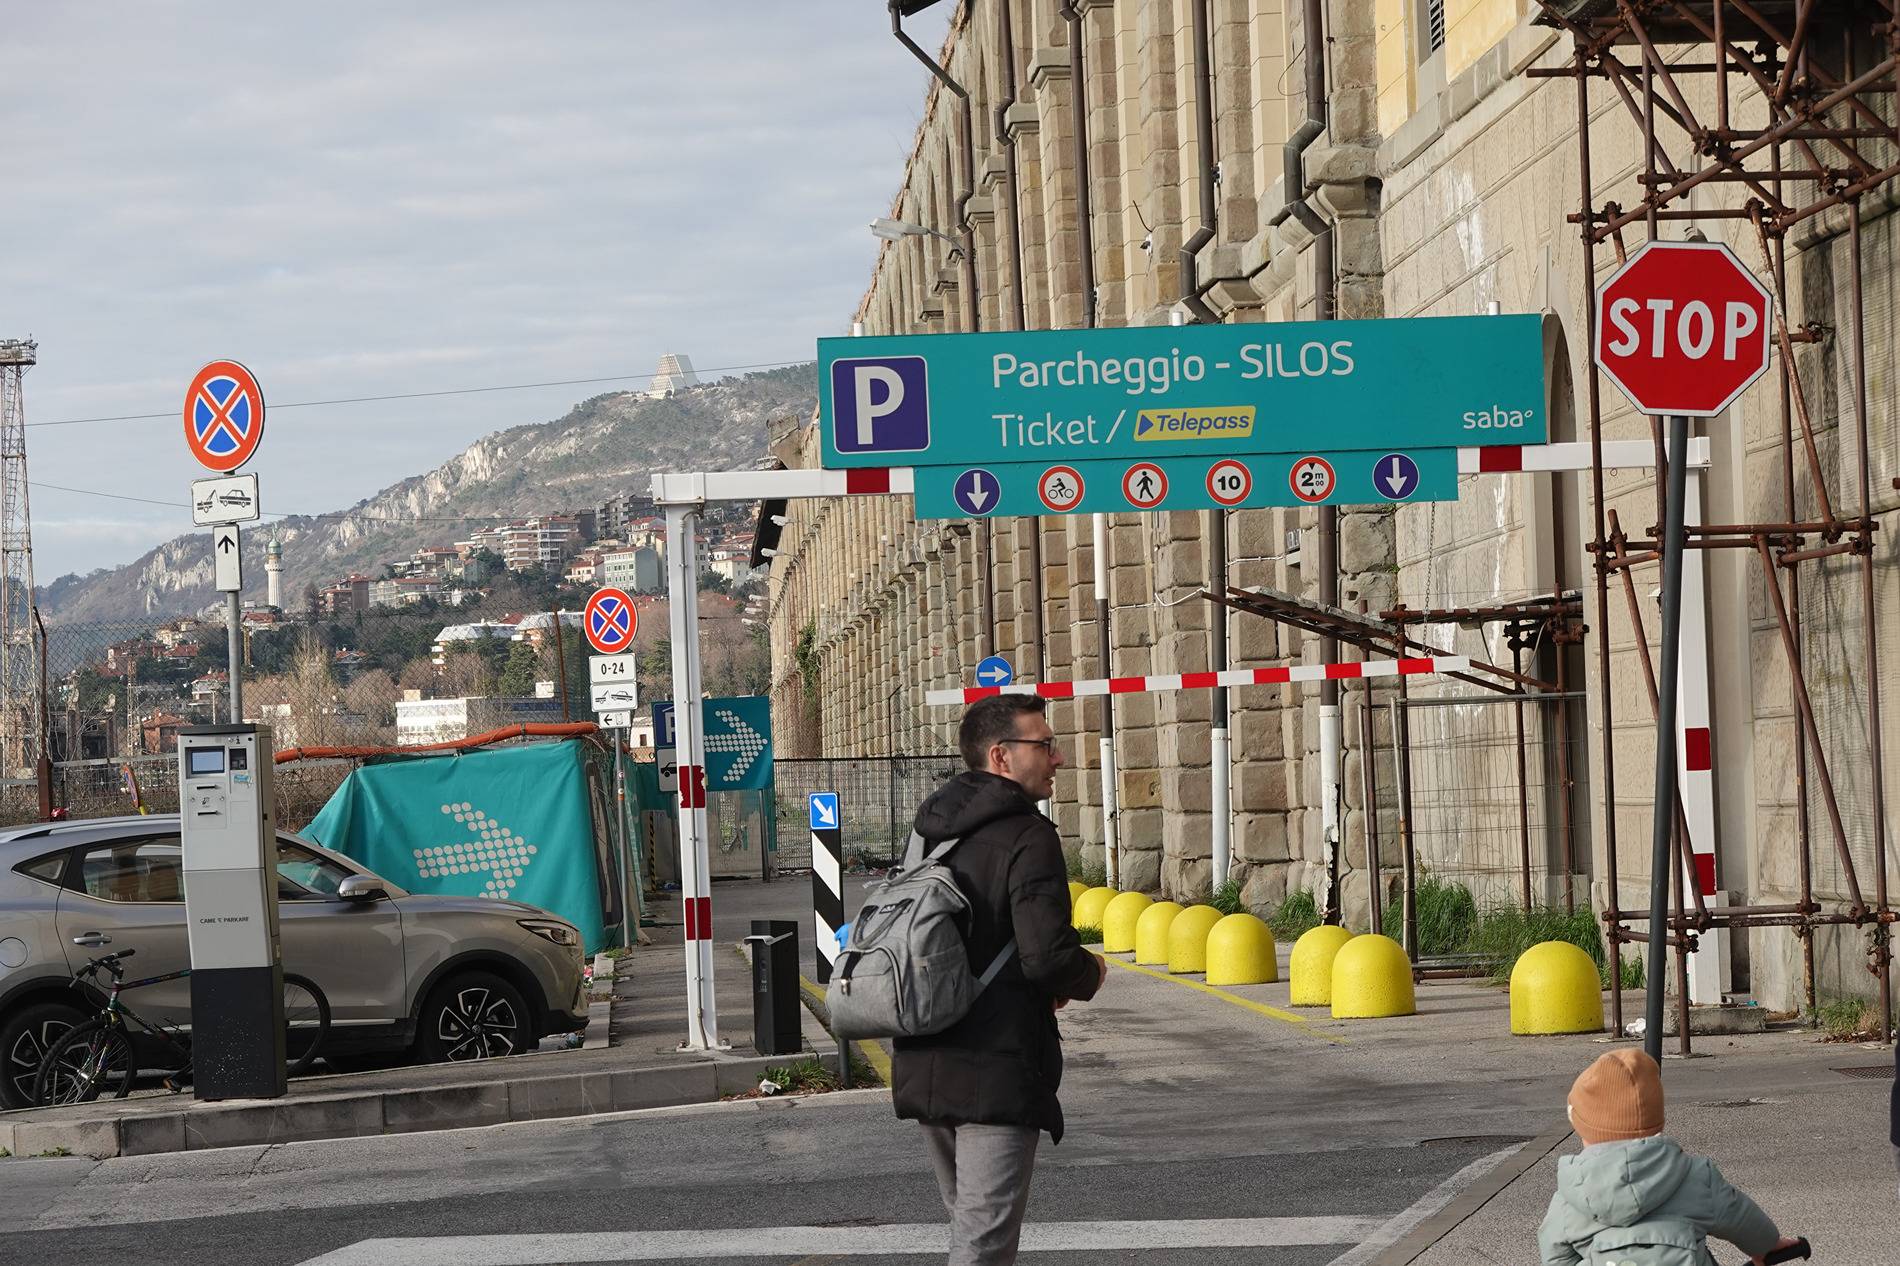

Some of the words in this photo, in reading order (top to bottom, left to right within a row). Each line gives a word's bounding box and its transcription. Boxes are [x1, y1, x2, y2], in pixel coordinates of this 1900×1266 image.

[1608, 297, 1758, 361] STOP
[992, 347, 1206, 395] Parcheggio
[1239, 340, 1355, 379] SILOS
[854, 365, 905, 445] P
[991, 411, 1099, 447] Ticket
[1156, 411, 1250, 435] Telepass
[1217, 475, 1241, 491] 10
[601, 661, 625, 675] 0-24
